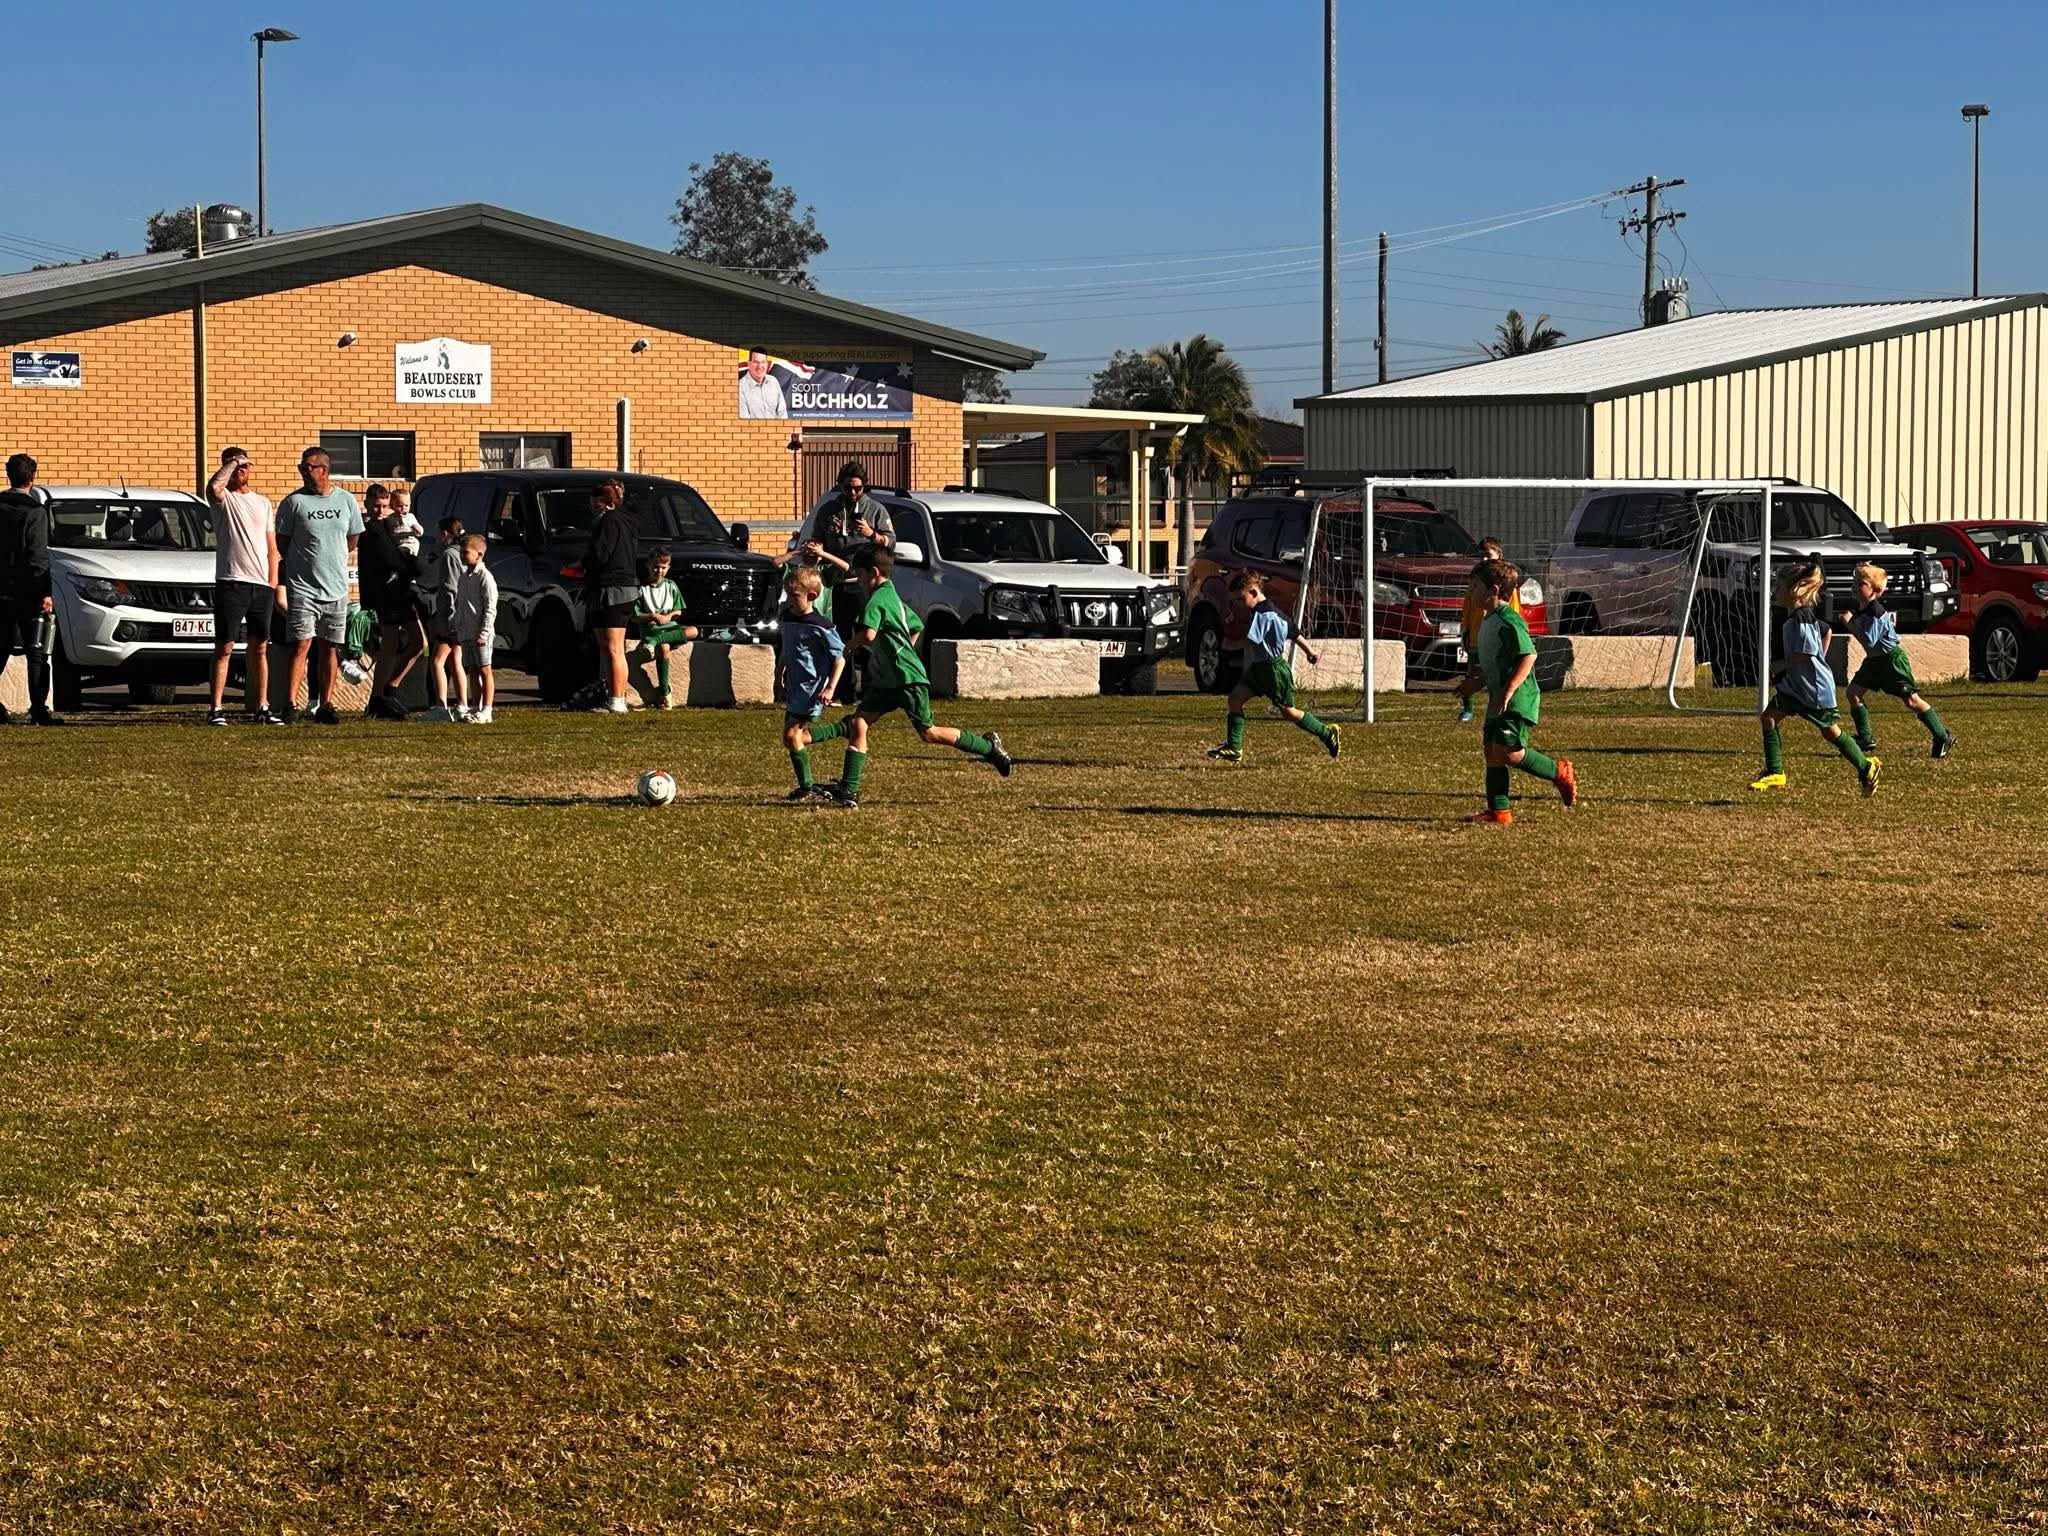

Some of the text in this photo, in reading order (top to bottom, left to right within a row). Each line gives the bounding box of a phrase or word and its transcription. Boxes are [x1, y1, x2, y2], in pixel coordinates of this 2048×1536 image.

[43, 358, 61, 366] Game
[404, 372, 483, 385] BEAUDESERT
[410, 388, 476, 399] BOWLS CLUB
[791, 383, 822, 393] SCOTT
[791, 393, 889, 409] BUCHHOLZ
[307, 509, 341, 520] KSCY
